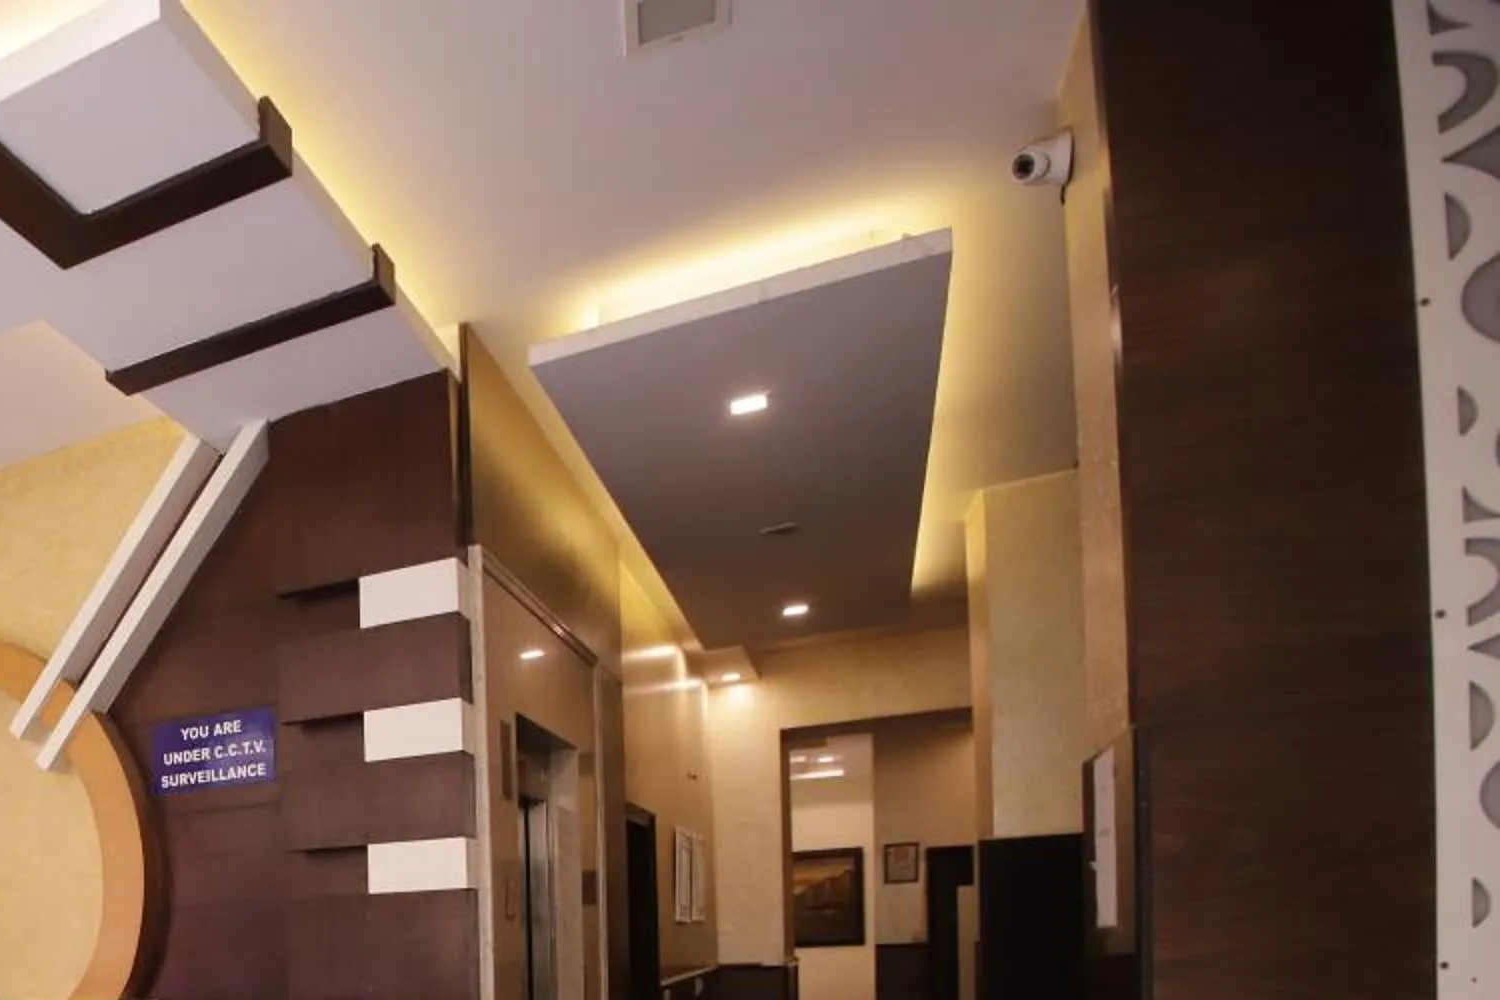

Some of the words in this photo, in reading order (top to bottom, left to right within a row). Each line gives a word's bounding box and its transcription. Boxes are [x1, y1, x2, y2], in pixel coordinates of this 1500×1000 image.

[181, 725, 209, 740] YOU
[214, 720, 242, 737] ARE
[163, 747, 210, 766] UNDER
[161, 763, 267, 789] SURVEILLANCE
